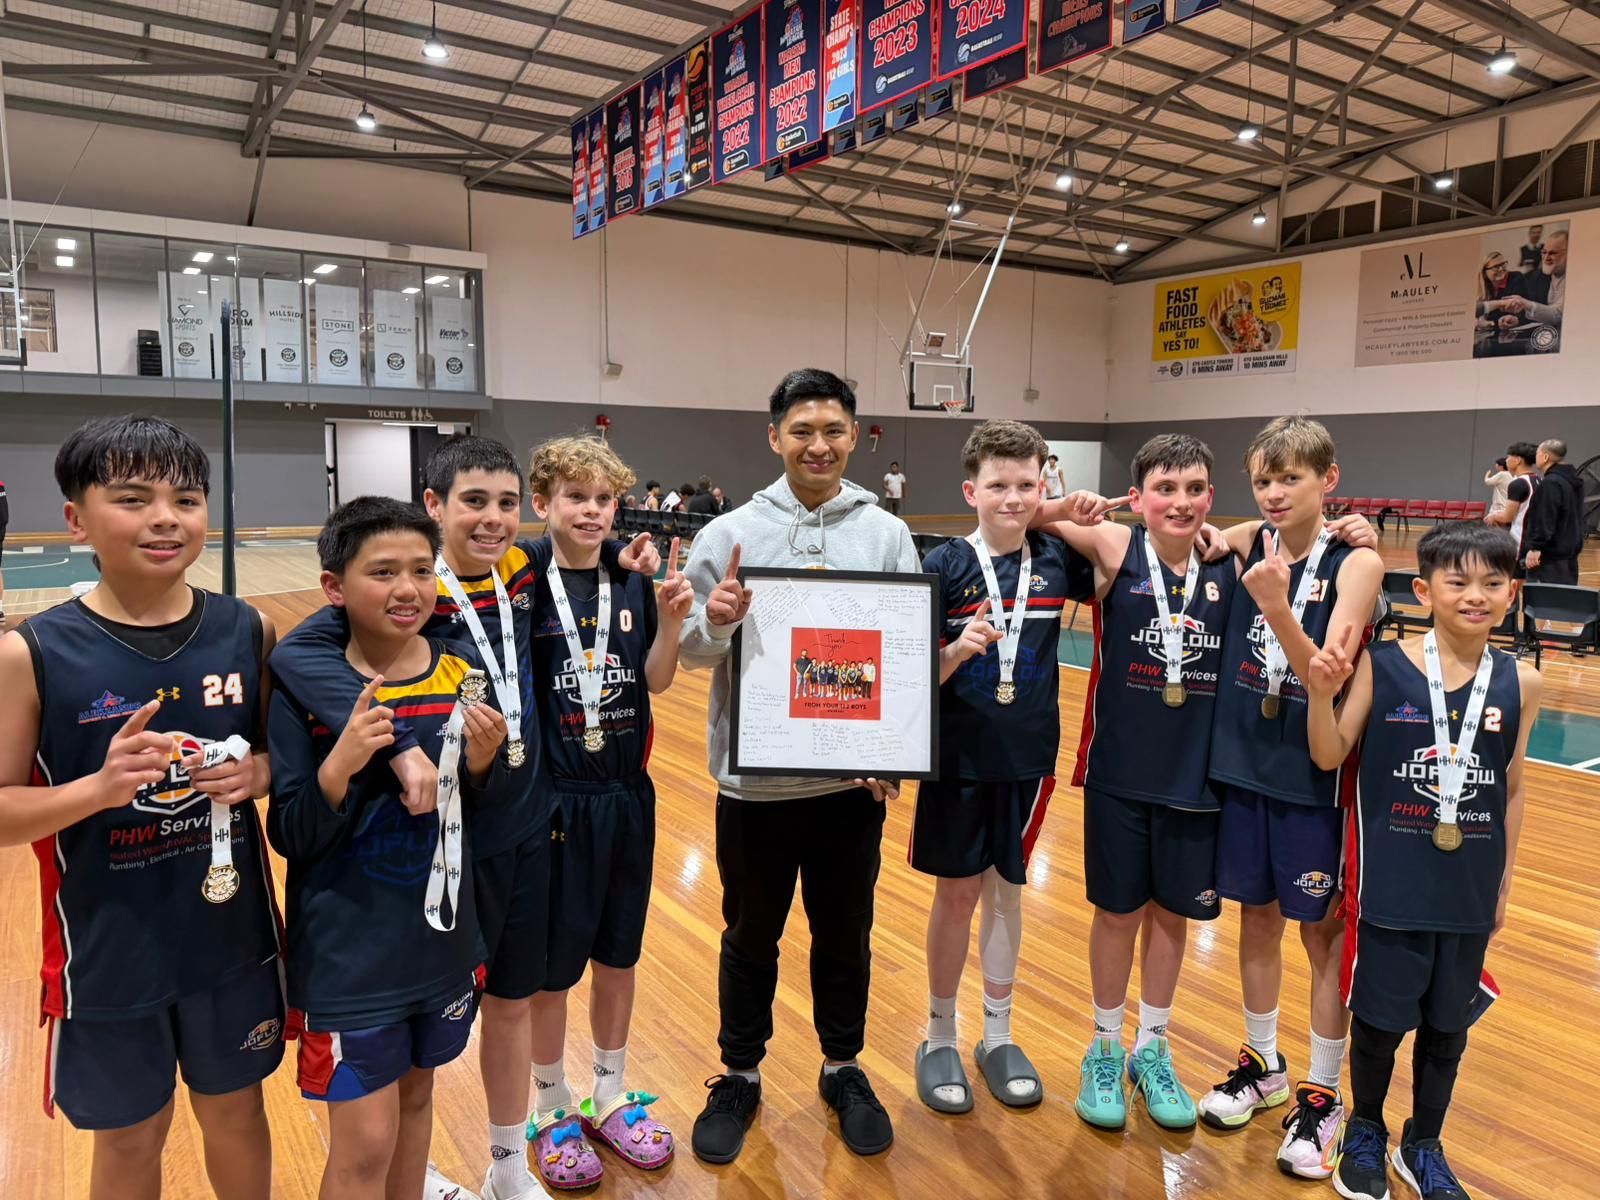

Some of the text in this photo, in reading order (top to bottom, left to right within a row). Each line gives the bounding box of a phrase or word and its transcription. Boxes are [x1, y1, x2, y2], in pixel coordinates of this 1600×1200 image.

[830, 8, 850, 31] STATE
[868, 0, 926, 41] CHAMPIONS
[956, 0, 1006, 39] 2024
[826, 22, 854, 49] CHAMPS
[873, 20, 919, 69] 2023
[770, 69, 816, 108] CHAMPIONS
[776, 95, 807, 131] 2022
[722, 120, 750, 154] 2022
[1167, 287, 1199, 304] FAST
[1166, 303, 1198, 320] FOOD
[325, 321, 351, 329] STONE
[1158, 316, 1206, 333] ATHLETES
[1163, 338, 1199, 352] YES TO!
[1198, 366, 1214, 374] MINS
[1215, 364, 1233, 372] AWAY
[1251, 361, 1265, 369] MINS
[368, 410, 406, 419] TOILETS
[1204, 581, 1220, 602] 6
[1309, 579, 1329, 602] 21
[619, 609, 633, 632] 0
[824, 632, 846, 643] Thank
[1131, 628, 1220, 649] JOOW
[552, 669, 636, 690] JOOW
[1129, 662, 1162, 677] PHW
[203, 672, 243, 707] 24
[599, 707, 636, 721] ervices
[1484, 706, 1502, 733] 2
[1391, 803, 1431, 817] PHW
[110, 810, 241, 849] PHW Servies
[185, 844, 197, 853] Air
